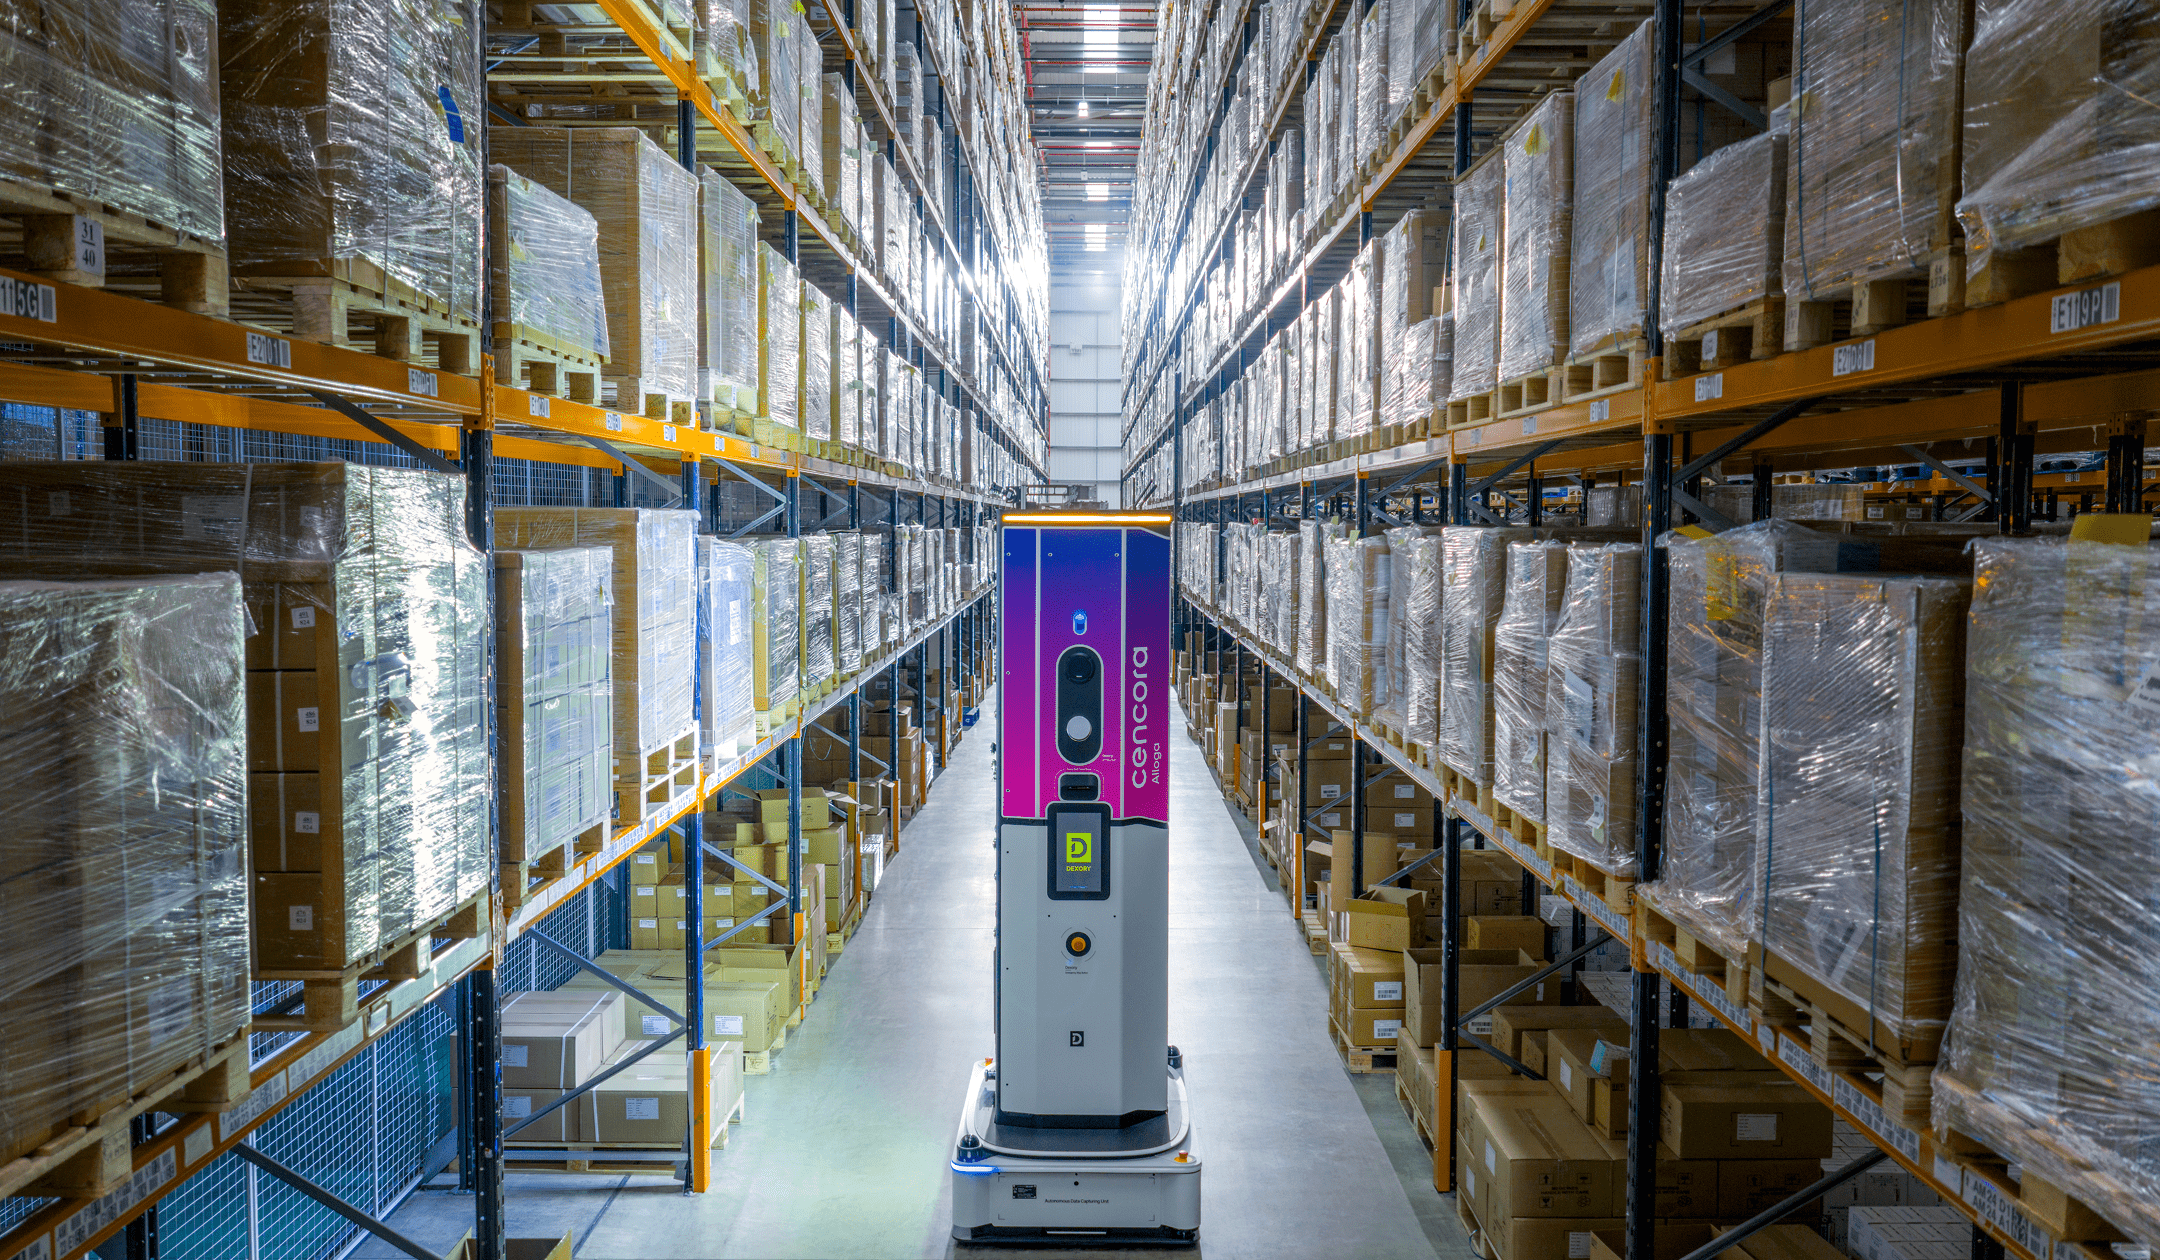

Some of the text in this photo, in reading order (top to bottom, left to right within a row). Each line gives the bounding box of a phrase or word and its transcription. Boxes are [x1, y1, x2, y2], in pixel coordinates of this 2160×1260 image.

[82, 221, 94, 241] 31
[83, 249, 95, 267] 40
[1132, 646, 1148, 789] cencora
[1151, 742, 1162, 785] Alloga
